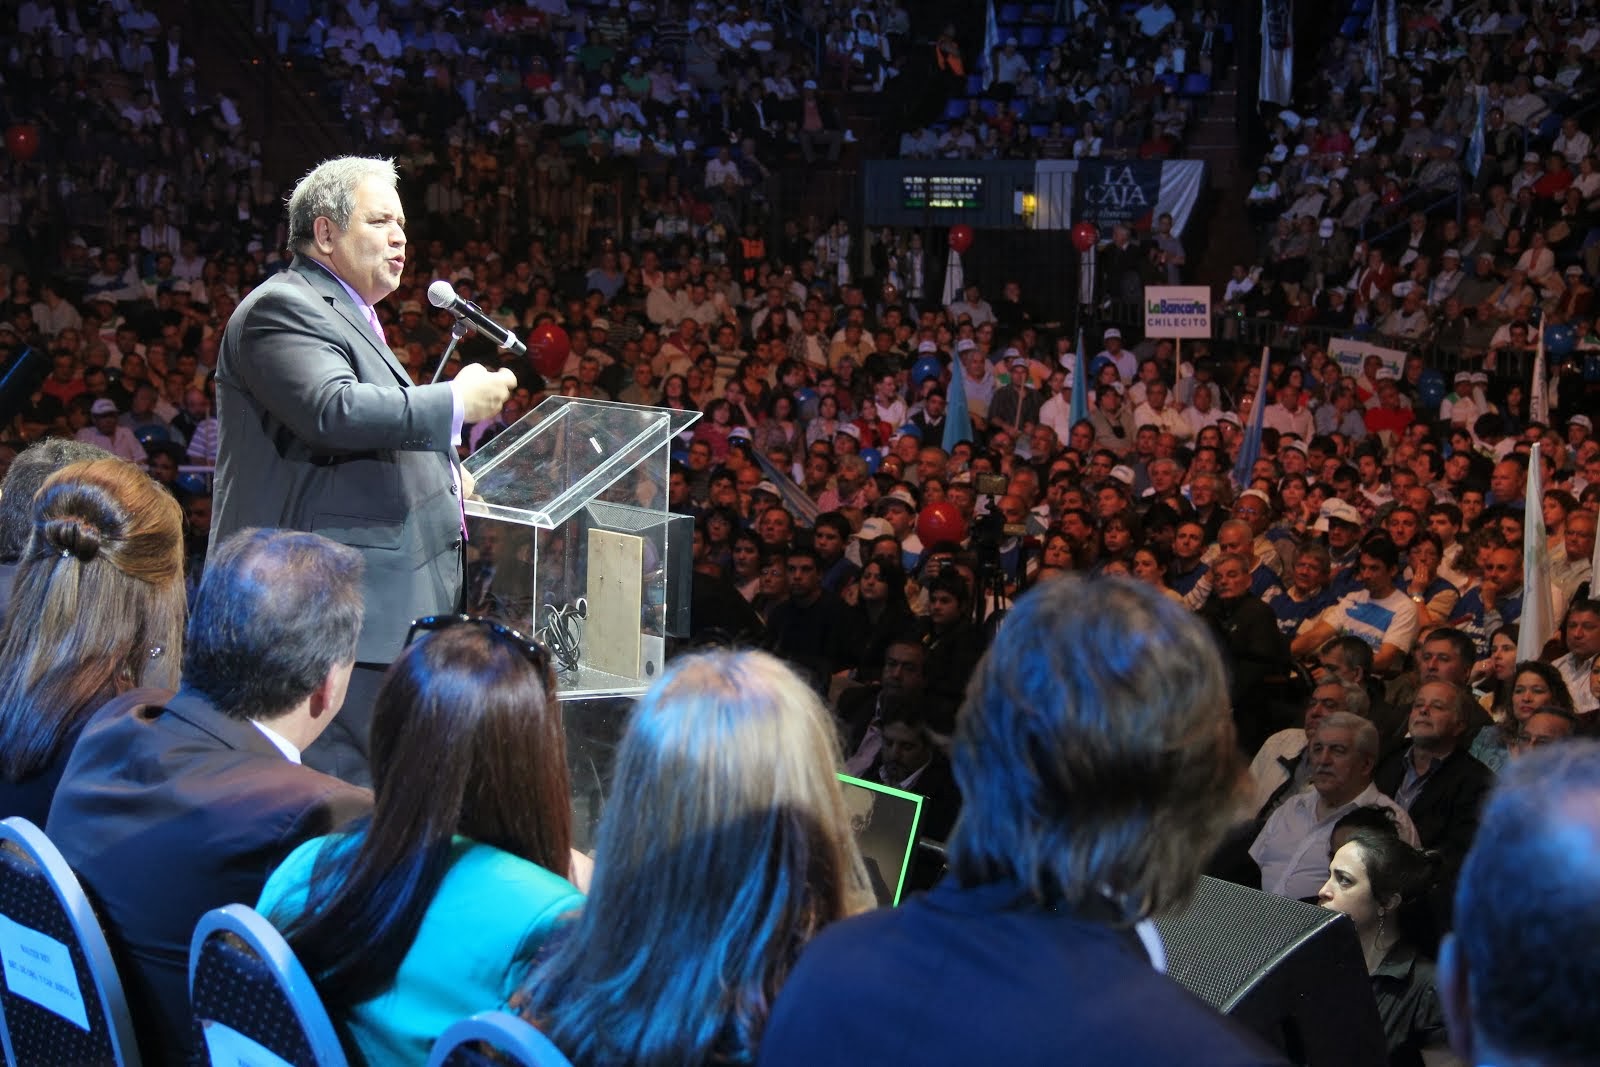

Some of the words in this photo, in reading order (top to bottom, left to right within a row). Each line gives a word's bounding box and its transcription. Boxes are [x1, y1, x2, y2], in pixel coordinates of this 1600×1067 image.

[1104, 166, 1136, 185] LA
[1085, 185, 1147, 208] CAJA
[1147, 318, 1207, 327] CHILECITO
